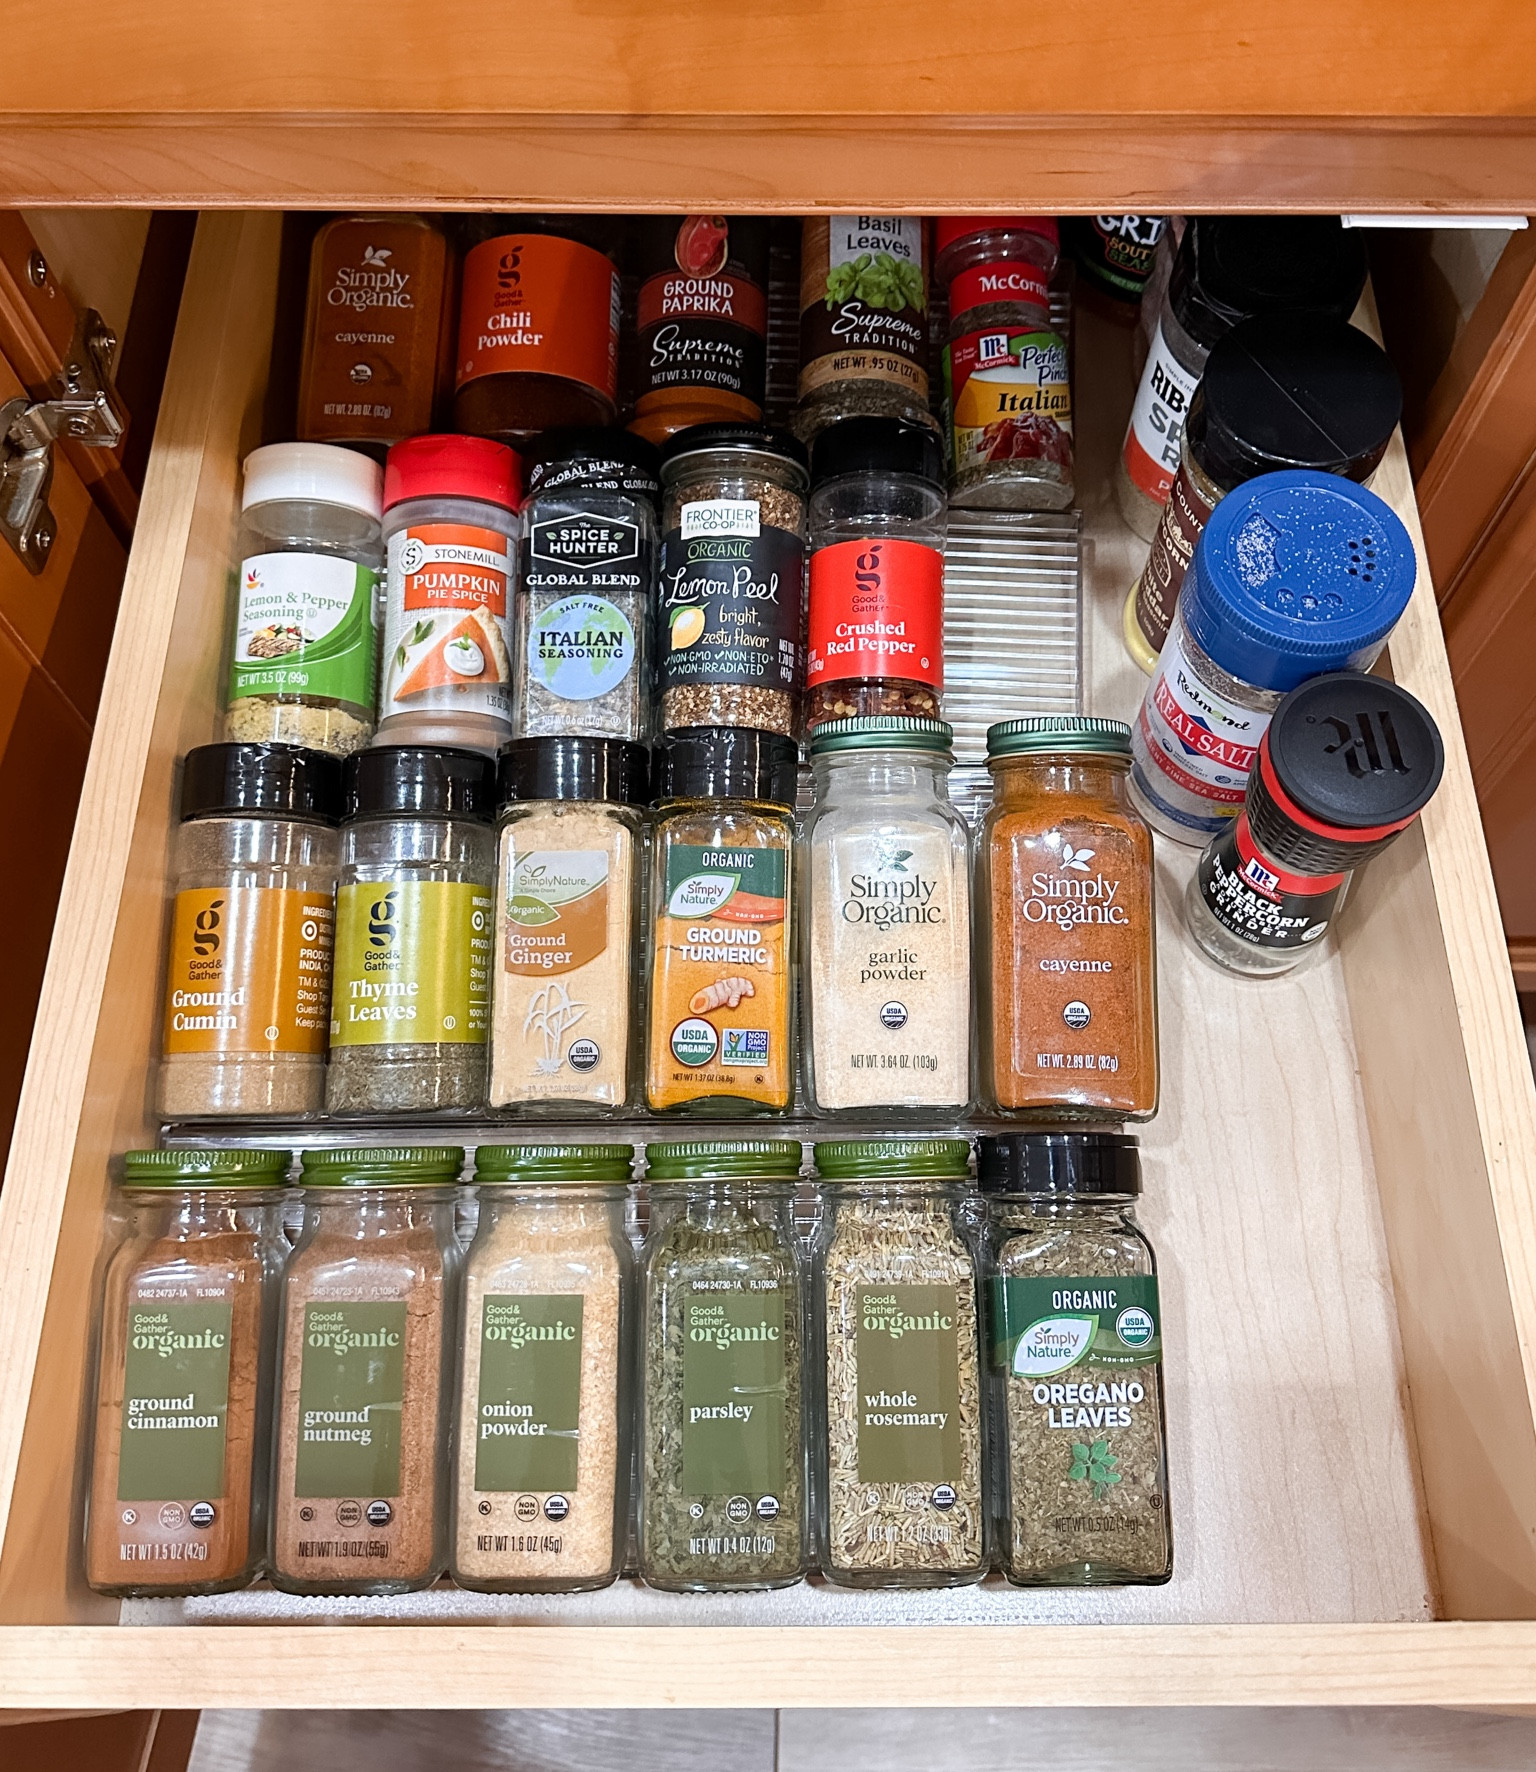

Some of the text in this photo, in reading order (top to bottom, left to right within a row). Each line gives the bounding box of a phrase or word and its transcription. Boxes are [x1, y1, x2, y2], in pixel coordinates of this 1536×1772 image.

[857, 216, 902, 236] Basil
[846, 232, 911, 258] Leaves
[336, 267, 410, 295] Simply
[663, 279, 734, 299] GROUND
[662, 296, 734, 316] PAPRIKA
[487, 310, 532, 330] Chili
[831, 302, 922, 341] Supreme
[335, 333, 396, 346] cayenne
[477, 329, 544, 351] Powder
[650, 324, 744, 367] Supreme
[844, 332, 919, 355] TRADITION
[669, 353, 742, 370] TRADITION
[833, 357, 899, 373] NET WT OZ
[651, 369, 741, 389] NET WT 3.17 OZ (90g)
[996, 391, 1068, 412] Italian
[544, 466, 586, 488] GLOBAL
[588, 461, 625, 473] BLEND
[686, 510, 754, 524] FRONTIER
[702, 521, 735, 530] CO-OP
[559, 528, 610, 541] SPICE
[549, 541, 619, 554] HUNTER
[687, 542, 752, 559] ORGANIC
[412, 573, 501, 597] PUMPKIN
[525, 573, 641, 586] GLOBAL BLEND
[665, 564, 779, 608] Lemon Peel
[243, 591, 349, 612] Lemon & Pepper
[427, 588, 489, 604] PIE SPICE
[242, 604, 305, 624] Seasoning
[559, 602, 605, 616] SALT FREE
[719, 603, 761, 628] bright,
[851, 603, 884, 614] Gather
[701, 627, 770, 649] zesty flavor
[834, 620, 906, 637] Crushed
[538, 630, 624, 647] ITALIAN
[826, 637, 916, 658] Red Pepper
[538, 647, 624, 659] SEASONING
[669, 651, 711, 665] NON-GMO
[677, 661, 764, 676] NON-IRRADIATED
[237, 671, 309, 689] NET WT 3.5 OZ (99g)
[1176, 669, 1250, 732] Redmond
[1156, 682, 1195, 743] REAL
[1196, 734, 1256, 771] SALT
[1188, 782, 1239, 802] SEA SALT
[702, 852, 755, 869] ORGANIC
[687, 883, 724, 901] Simply
[849, 873, 938, 905] Simply
[1031, 873, 1120, 906] Simply
[1212, 853, 1311, 929] PEPPERCORN
[1228, 870, 1284, 917] BLACK
[510, 903, 545, 917] Organic
[1209, 880, 1289, 940] GRINDER
[510, 933, 566, 947] Ground
[686, 926, 762, 945] GROUND
[510, 948, 573, 969] Ginger
[678, 945, 768, 965] TURMERIC
[868, 948, 919, 970] garlic
[188, 970, 223, 981] Gather
[364, 960, 401, 972] Gather
[860, 966, 927, 985] powder
[1039, 958, 1113, 975] cayenne
[172, 987, 246, 1009] Ground
[297, 989, 318, 1003] Shop
[349, 978, 420, 1003] Thyme
[349, 1004, 418, 1023] Leaves
[886, 1007, 902, 1015] USDA
[172, 1012, 239, 1032] Cumin
[295, 1016, 316, 1030] Keep
[681, 1028, 709, 1042] USDA
[747, 1032, 767, 1040] NON
[747, 1038, 767, 1046] GMO
[575, 1046, 593, 1054] USDA
[677, 1043, 712, 1055] ORGANIC
[725, 1051, 767, 1059] VERIFIED
[747, 1044, 767, 1053] Project
[851, 1054, 938, 1072] NET 3.64 (103g)
[1037, 1053, 1119, 1073] NET 2.89 (82g)
[672, 1072, 716, 1083] NET WT 1.37 OZ
[1052, 1288, 1118, 1311] ORGANIC
[486, 1314, 520, 1325] Gather
[863, 1305, 897, 1315] Gather
[133, 1324, 168, 1334] Gather
[309, 1321, 344, 1332] Gather
[690, 1315, 725, 1326] Gather
[863, 1310, 953, 1340] organic
[1124, 1317, 1146, 1327] USDA
[132, 1328, 225, 1359] organic
[308, 1325, 401, 1357] organic
[485, 1320, 576, 1350] organic
[690, 1321, 780, 1351] organic
[1034, 1330, 1080, 1349] Simply
[864, 1390, 918, 1408] whole
[1032, 1381, 1146, 1405] OREGANO
[127, 1393, 195, 1416] ground
[482, 1400, 534, 1418] onion
[689, 1401, 754, 1425] parsley
[127, 1412, 219, 1431] cinnamon
[303, 1406, 371, 1427] ground
[864, 1412, 949, 1430] rosemary
[1048, 1406, 1133, 1429] LEAVES
[303, 1427, 373, 1446] nutmeg
[481, 1419, 549, 1440] powder
[163, 1508, 181, 1517] NON
[517, 1509, 536, 1517] GMO
[518, 1501, 536, 1509] NON
[729, 1509, 748, 1518] GMO
[730, 1502, 748, 1511] NON
[120, 1542, 208, 1561] NET WT 1.5 OZ (42g)
[298, 1541, 365, 1558] NET WT OZ
[477, 1534, 563, 1554] NET WT 1.6 OZ (45g)
[689, 1536, 776, 1555] NET WT 0.4 OZ (12g)
